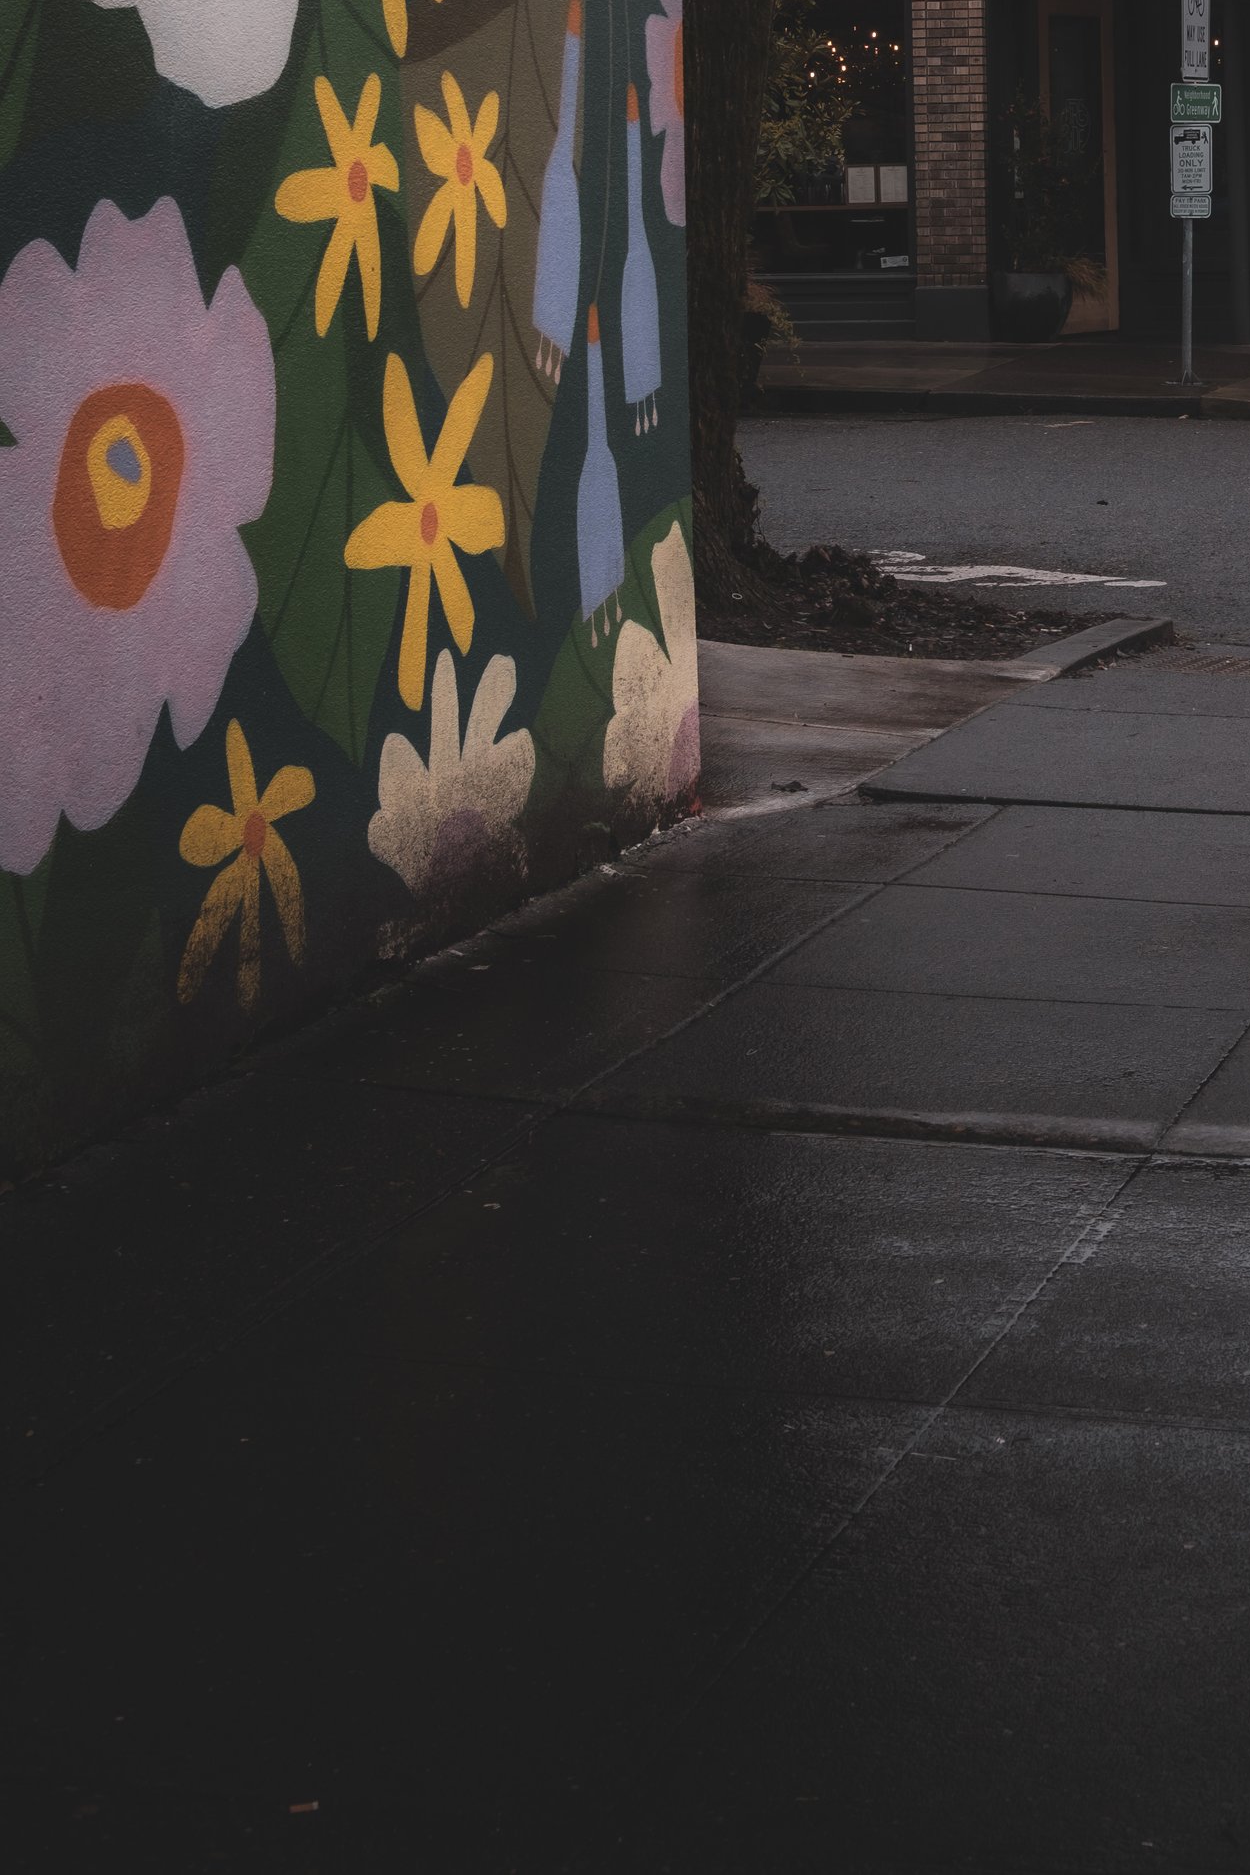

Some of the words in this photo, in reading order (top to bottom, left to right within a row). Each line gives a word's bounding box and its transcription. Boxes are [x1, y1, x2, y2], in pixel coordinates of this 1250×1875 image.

[1186, 24, 1196, 41] MAY
[1197, 26, 1206, 43] USE
[1185, 50, 1195, 67] FULL
[1196, 50, 1207, 68] LANE
[1186, 103, 1210, 118] Greenway
[1178, 151, 1204, 159] LOADING
[1179, 159, 1204, 168] ONLY
